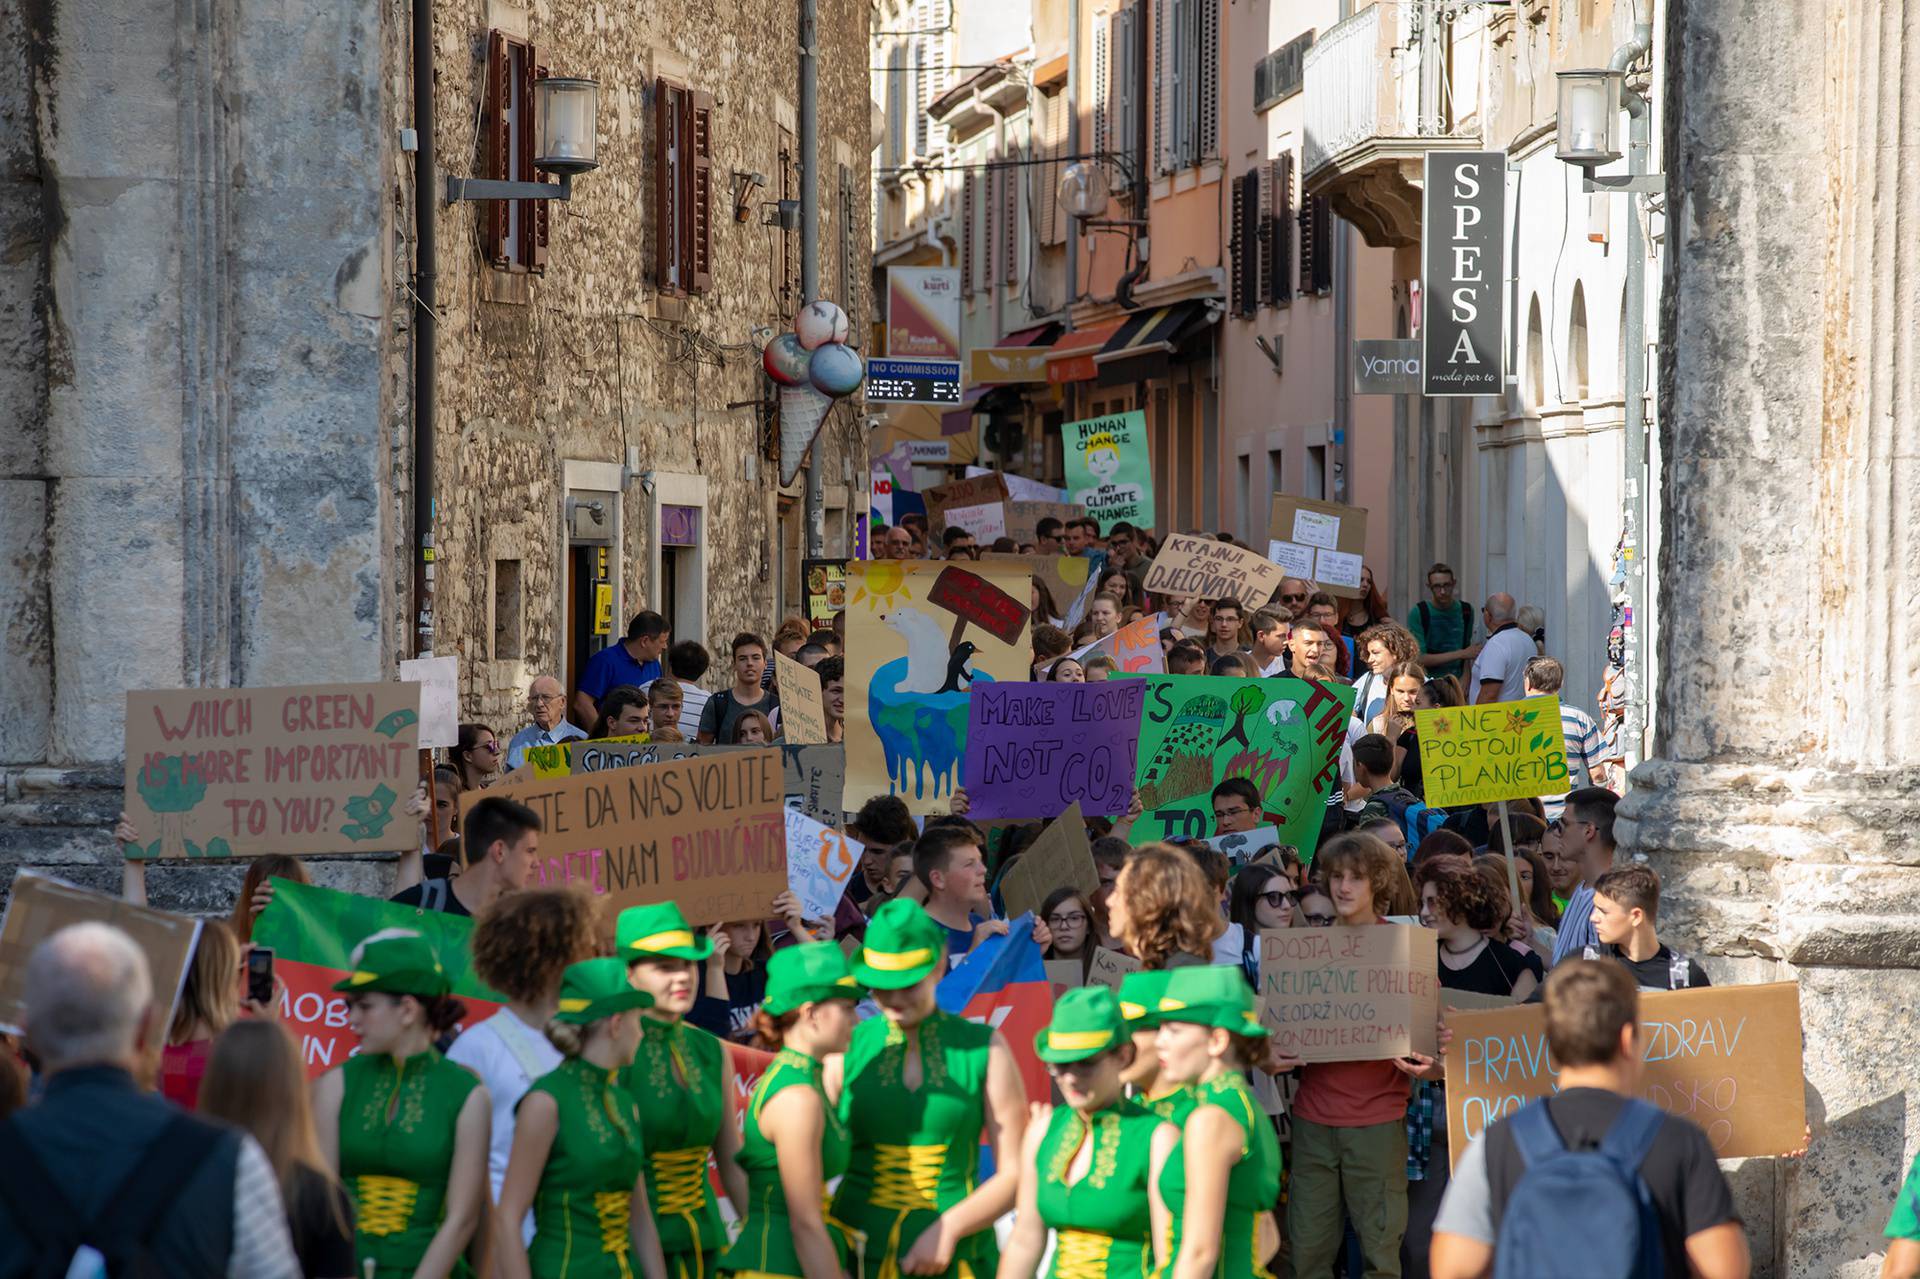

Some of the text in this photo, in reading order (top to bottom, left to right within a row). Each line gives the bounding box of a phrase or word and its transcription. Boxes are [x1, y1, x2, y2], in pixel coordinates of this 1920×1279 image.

[1447, 163, 1483, 364] SPESA
[923, 280, 949, 291] kurti
[871, 363, 957, 376] NO COMMISSION
[1431, 369, 1462, 382] moda
[1462, 374, 1483, 386] per
[1484, 373, 1497, 382] te
[1075, 433, 1131, 452] CHANGE
[1078, 417, 1127, 440] HUMAN
[1085, 490, 1137, 507] CLIMATE
[1098, 484, 1117, 495] NOT
[1088, 505, 1139, 521] CHANGE
[1169, 538, 1273, 578] KRAJNJI JE
[1187, 555, 1248, 582] ČAS ZA
[1147, 564, 1268, 611] DJELOVANJE
[153, 693, 375, 741] WHICH GREEN
[981, 690, 1055, 726] MAKE
[1072, 686, 1139, 722] LOVE
[1460, 709, 1502, 733] NE
[1301, 679, 1346, 794] TIME
[1422, 737, 1522, 759] POSTOJI
[143, 741, 411, 787] IS MORE IMPORTANT
[984, 740, 1063, 785] NOT
[585, 784, 618, 829] DA
[629, 769, 683, 818] NAS
[223, 796, 335, 837] TO YOU?
[1154, 808, 1207, 840] TO
[605, 840, 659, 893] NAM
[1265, 935, 1333, 961] DOSTA
[1266, 964, 1359, 996] NEUTAŽIVE
[1367, 968, 1428, 997] POHLEPE
[1270, 1023, 1409, 1048] KONZUMERIZMA
